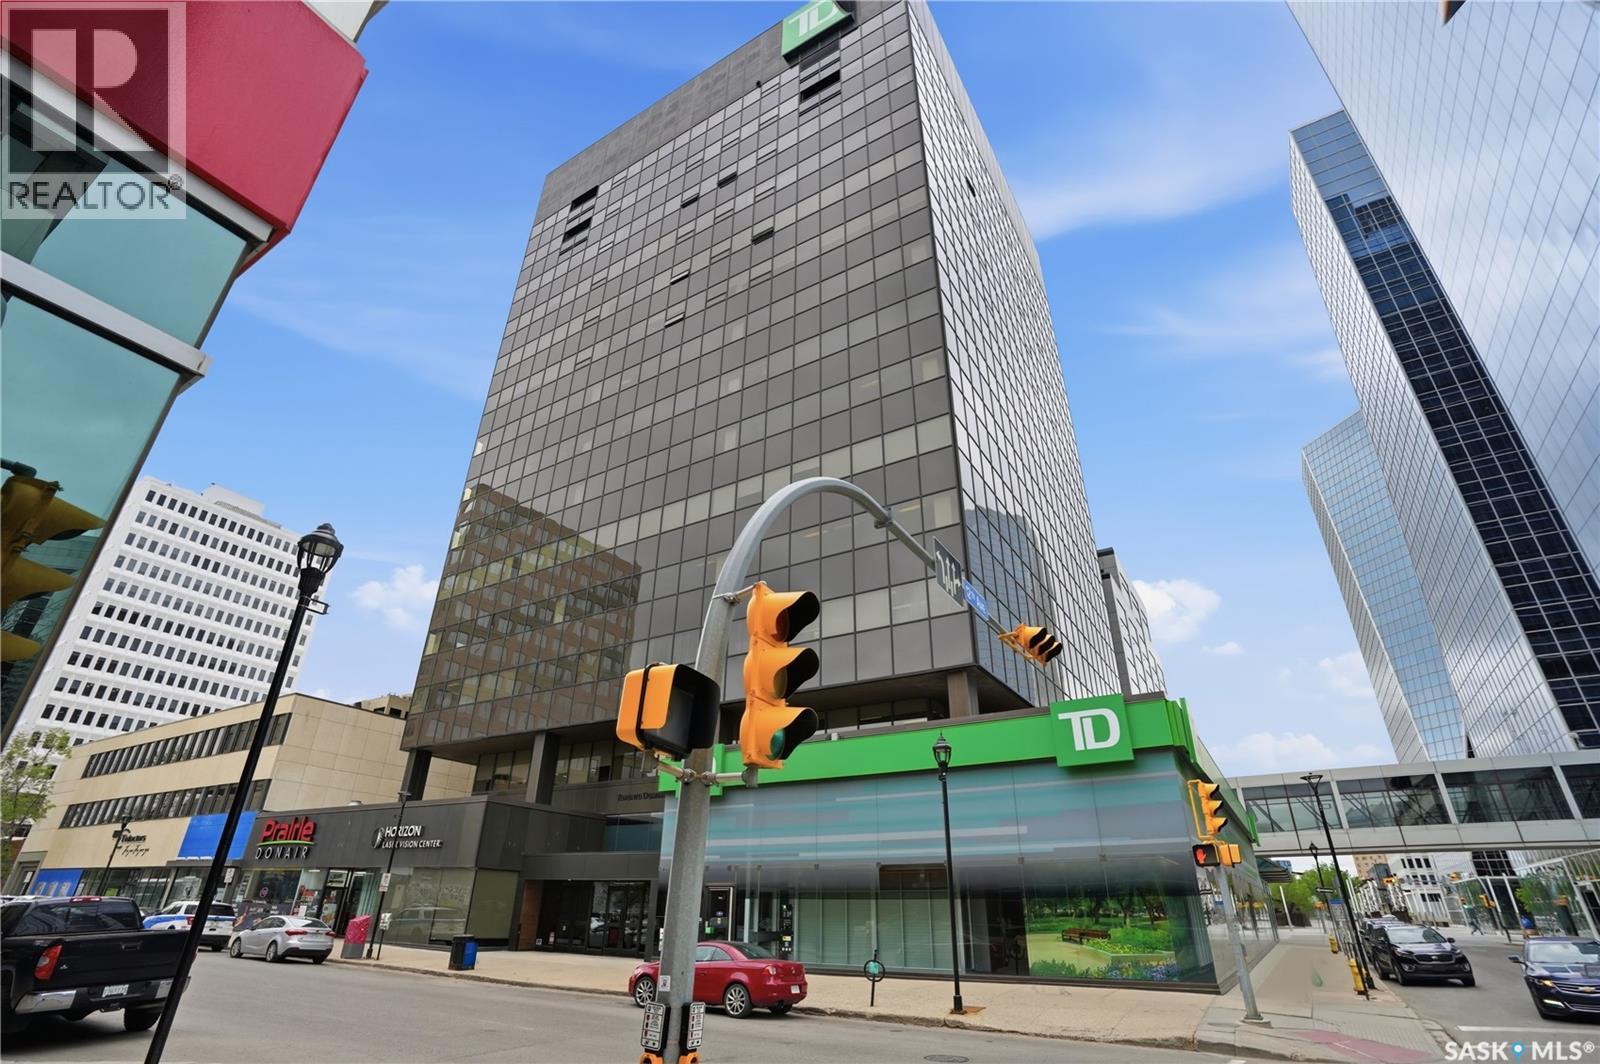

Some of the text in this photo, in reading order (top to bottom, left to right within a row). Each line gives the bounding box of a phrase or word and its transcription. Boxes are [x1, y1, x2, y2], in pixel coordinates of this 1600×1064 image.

[1057, 708, 1121, 752] TD
[258, 816, 316, 843] Prairie
[384, 825, 422, 838] HORIZON
[418, 840, 442, 848] CENTER
[255, 846, 309, 860] DONAIR
